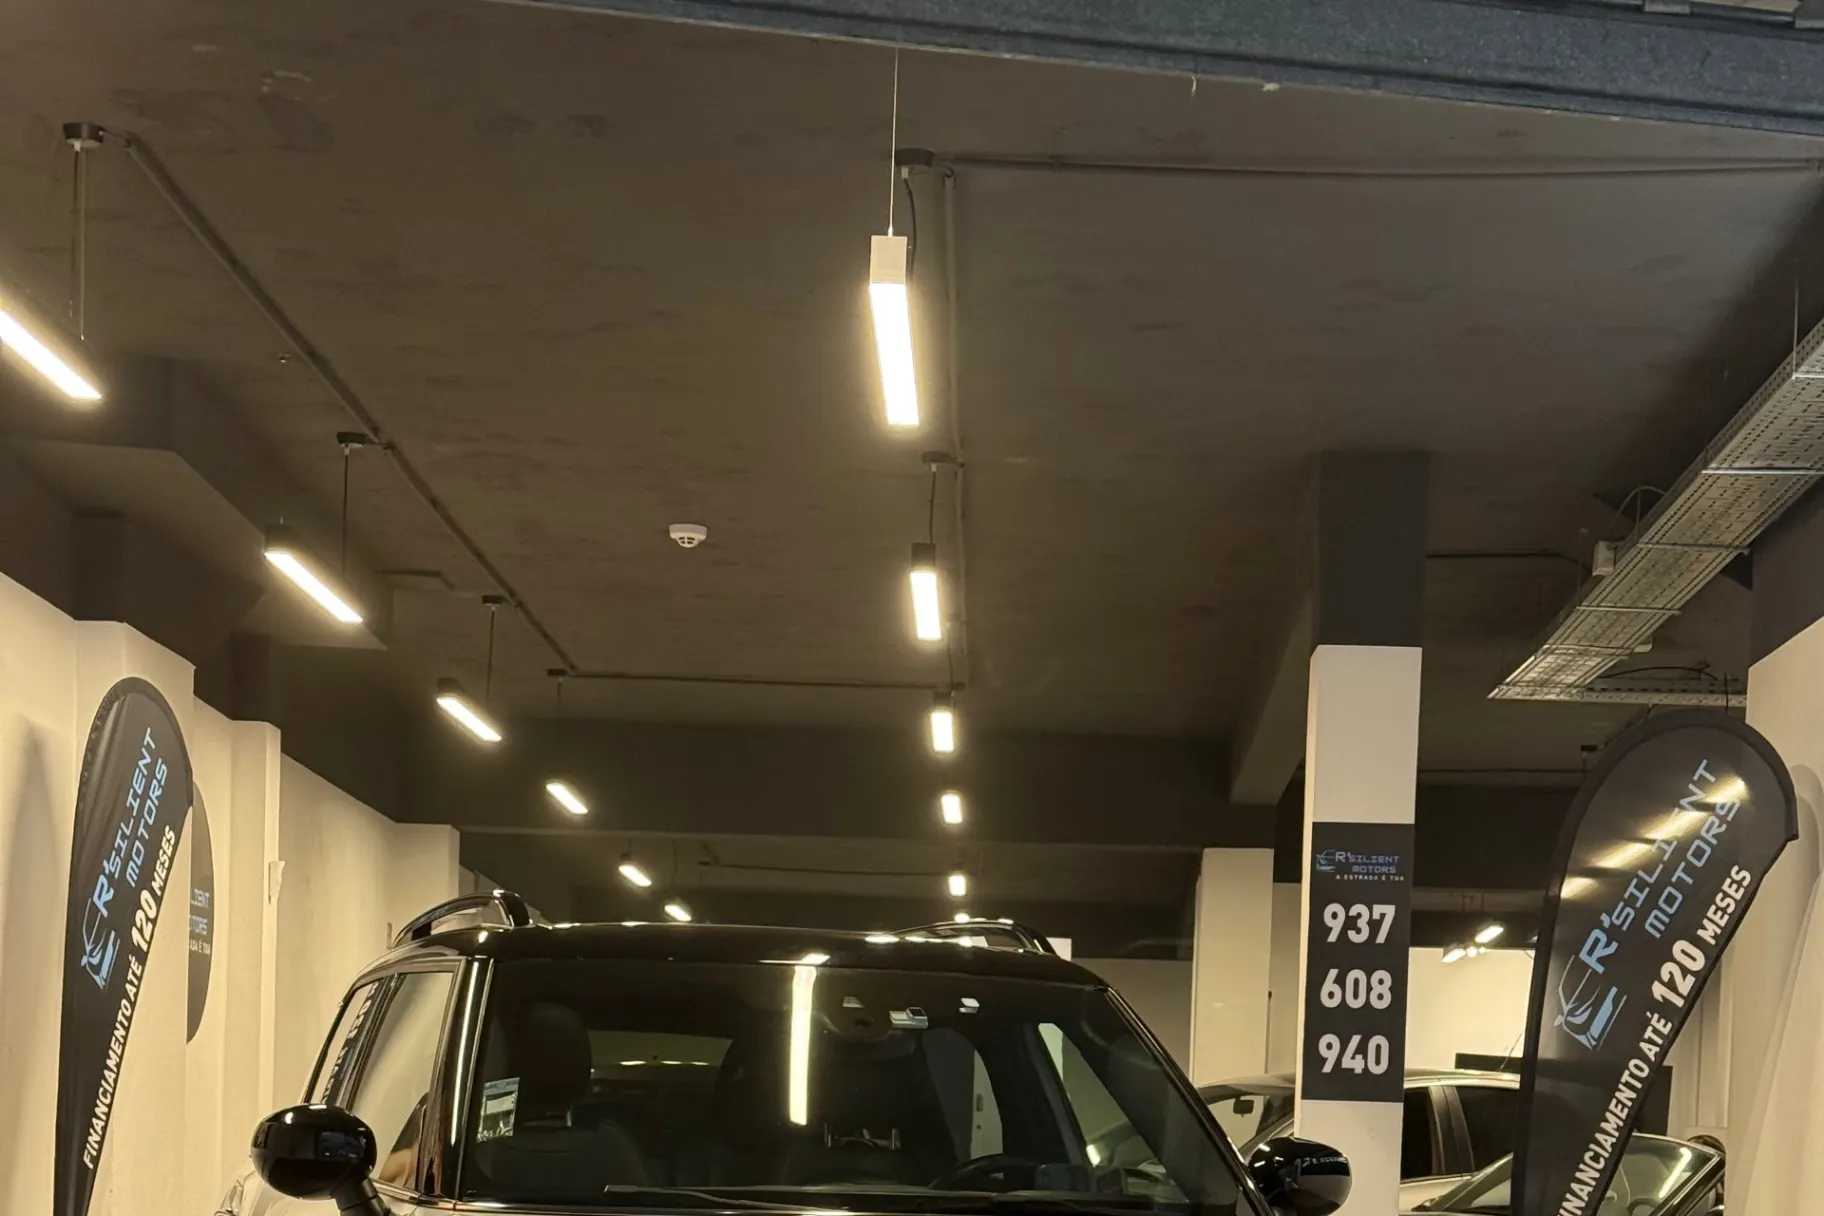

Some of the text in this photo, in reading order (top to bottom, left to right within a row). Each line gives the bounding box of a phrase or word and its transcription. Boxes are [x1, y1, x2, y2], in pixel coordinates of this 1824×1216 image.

[126, 757, 168, 888] MOTORS
[1352, 865, 1397, 873] MOTORS
[1644, 798, 1741, 939] MOTORS
[1323, 903, 1396, 944] 937
[1696, 864, 1752, 946] MESES
[83, 825, 176, 1170] FINANCIAMENTO ATÉ 120 MESES
[1320, 968, 1392, 1010] 608
[1651, 939, 1706, 1009] 120
[1318, 1033, 1390, 1075] 940
[1638, 1010, 1673, 1063] ATÉ
